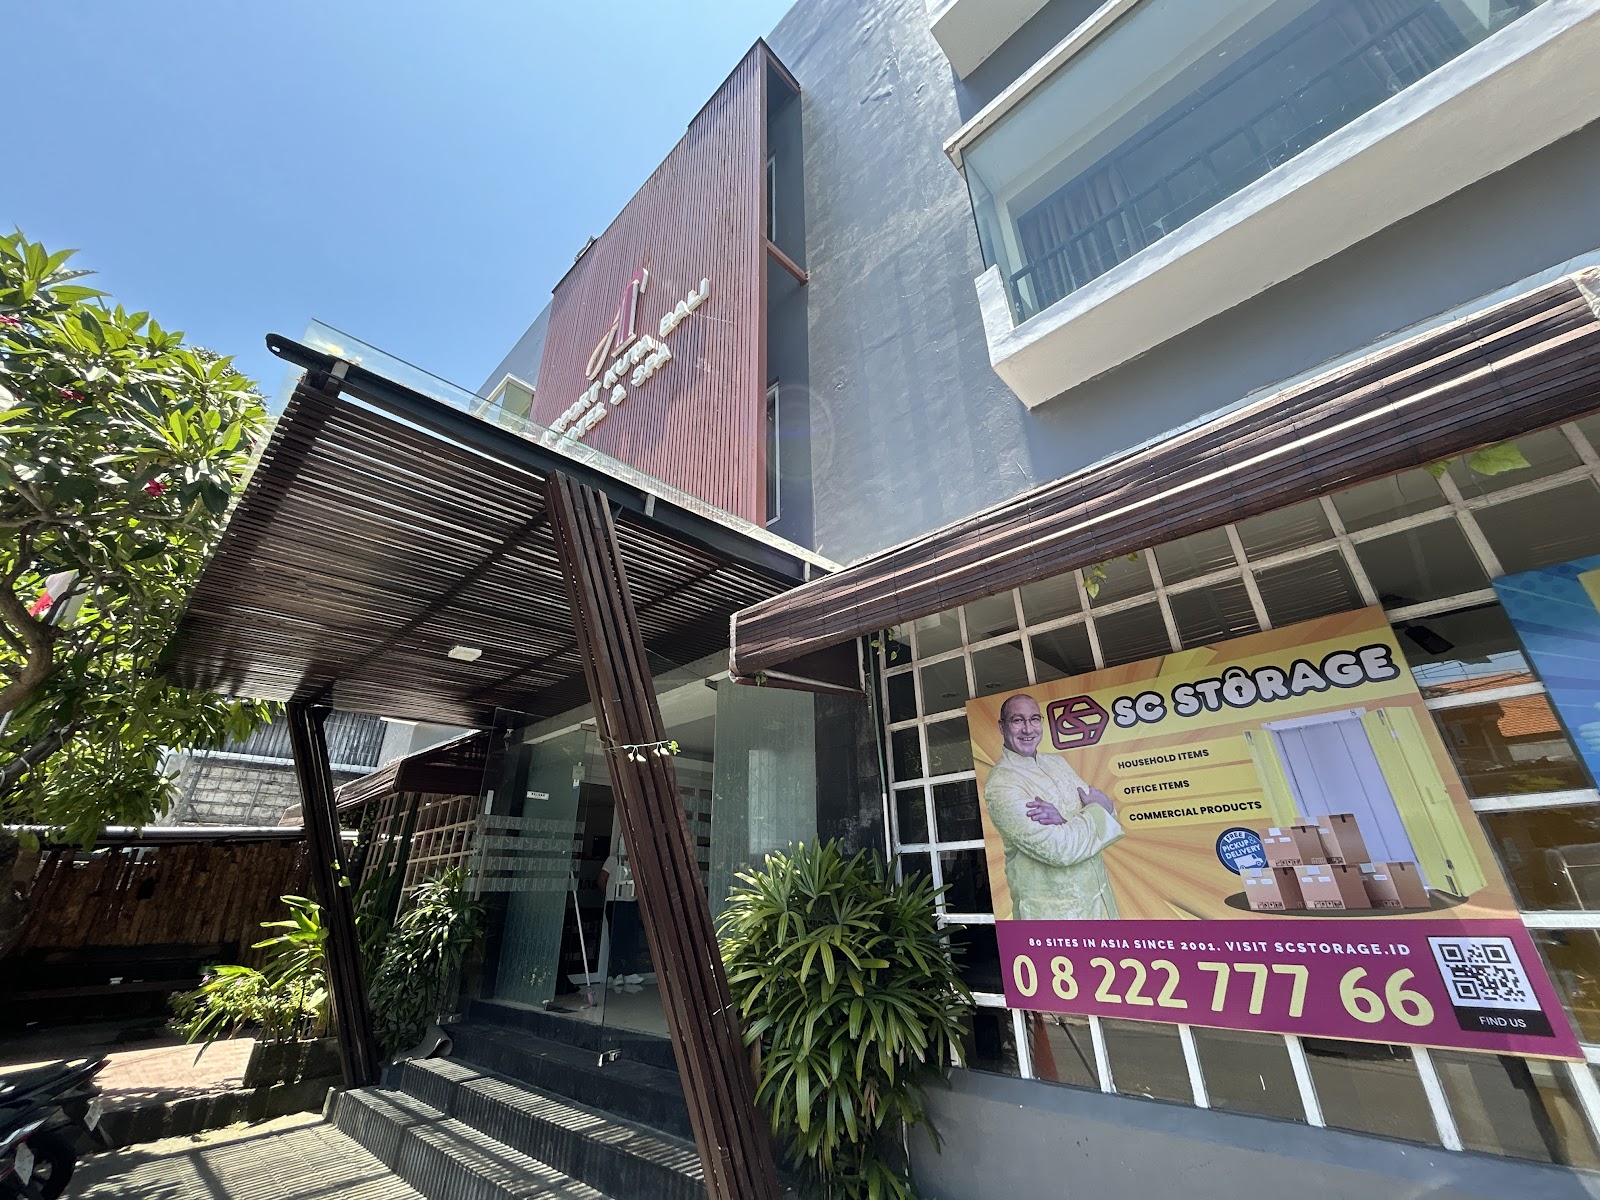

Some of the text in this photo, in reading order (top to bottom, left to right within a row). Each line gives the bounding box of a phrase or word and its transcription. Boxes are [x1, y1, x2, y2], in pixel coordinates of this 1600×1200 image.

[603, 334, 655, 389] KUTA
[659, 278, 710, 338] BALI
[610, 383, 627, 406] &
[631, 342, 672, 387] SPA
[1112, 643, 1400, 728] SC STORAGE
[1118, 749, 1209, 769] HOUSEHOLD ITEMS
[1123, 780, 1190, 795] OFFICE ITEMS
[1129, 801, 1262, 821] COMMERCIAL PRODUCTS
[1222, 836, 1258, 852] PICKUP &
[1226, 831, 1243, 841] FREE
[1225, 844, 1261, 859] DELIVERY
[1028, 937, 1411, 956] 80 SITES IN ASIA SINCE 2001. VISIT SCSTORAGE.ID
[1012, 954, 1435, 1027] 0 8 222 777 66
[1479, 1016, 1527, 1028] FIND US
